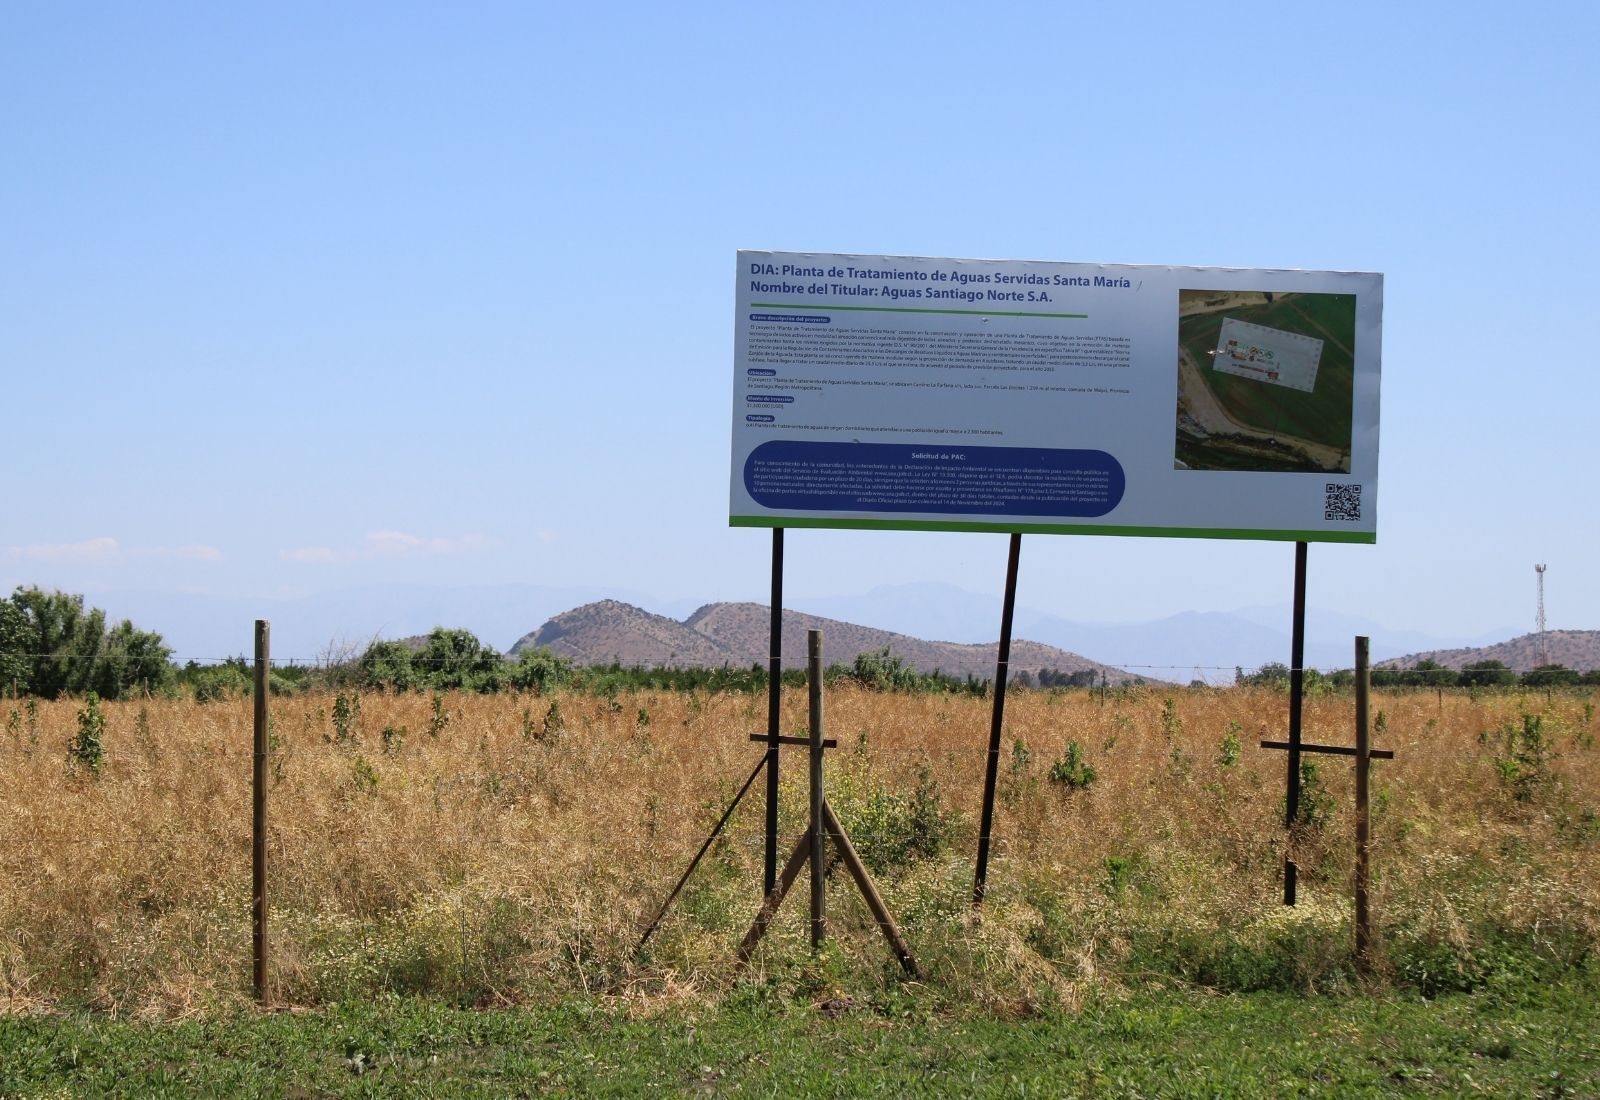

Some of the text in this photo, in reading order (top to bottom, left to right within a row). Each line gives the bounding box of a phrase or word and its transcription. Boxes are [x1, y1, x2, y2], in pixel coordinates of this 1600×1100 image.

[751, 263, 1130, 288] DIA: Planta de Tratamiento de Aguas Servidas Santa María
[750, 281, 1052, 303] Nombre del Titular: Aguas Santiago Norte S.A.
